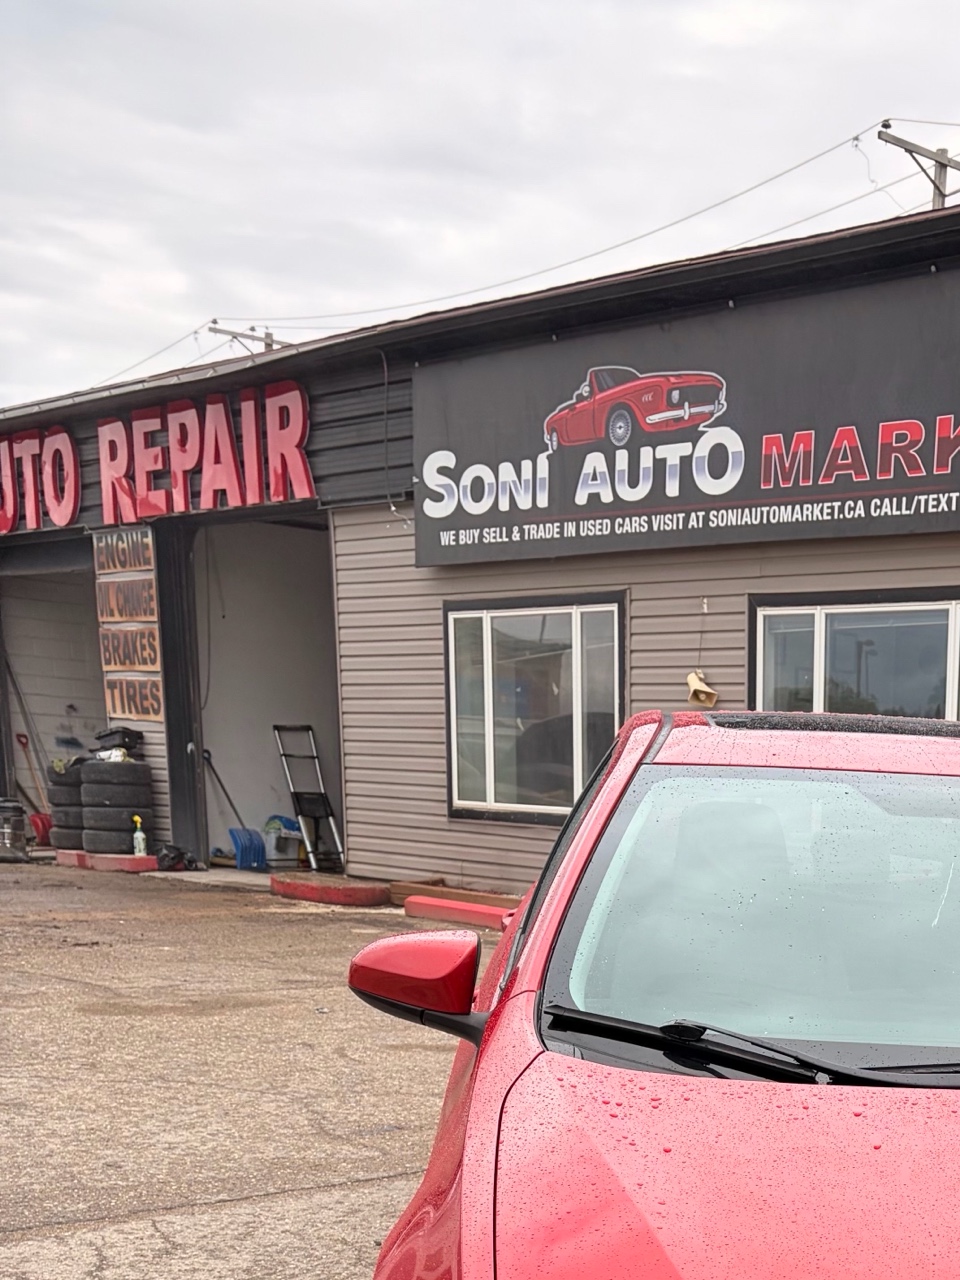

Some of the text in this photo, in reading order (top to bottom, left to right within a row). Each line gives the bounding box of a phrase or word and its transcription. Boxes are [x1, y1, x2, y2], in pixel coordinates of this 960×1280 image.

[97, 380, 315, 525] REPAIR
[574, 425, 746, 506] AUTO
[439, 530, 457, 546] WE
[458, 528, 480, 545] BUY
[482, 526, 510, 543] SELL
[511, 525, 521, 541] &
[522, 522, 561, 541] TRADE
[563, 521, 577, 538] IN
[579, 518, 612, 537] USED
[614, 516, 649, 535] CARS
[651, 512, 686, 532] VISIT
[687, 511, 706, 529] AT
[708, 499, 866, 528] SONIAUTOMARKET.CA
[870, 491, 960, 517] CALL/TEXT
[96, 531, 152, 572] ENGINE
[115, 581, 155, 617] CHANGE
[101, 631, 158, 667] BRAKES
[106, 680, 162, 717] TIRES
